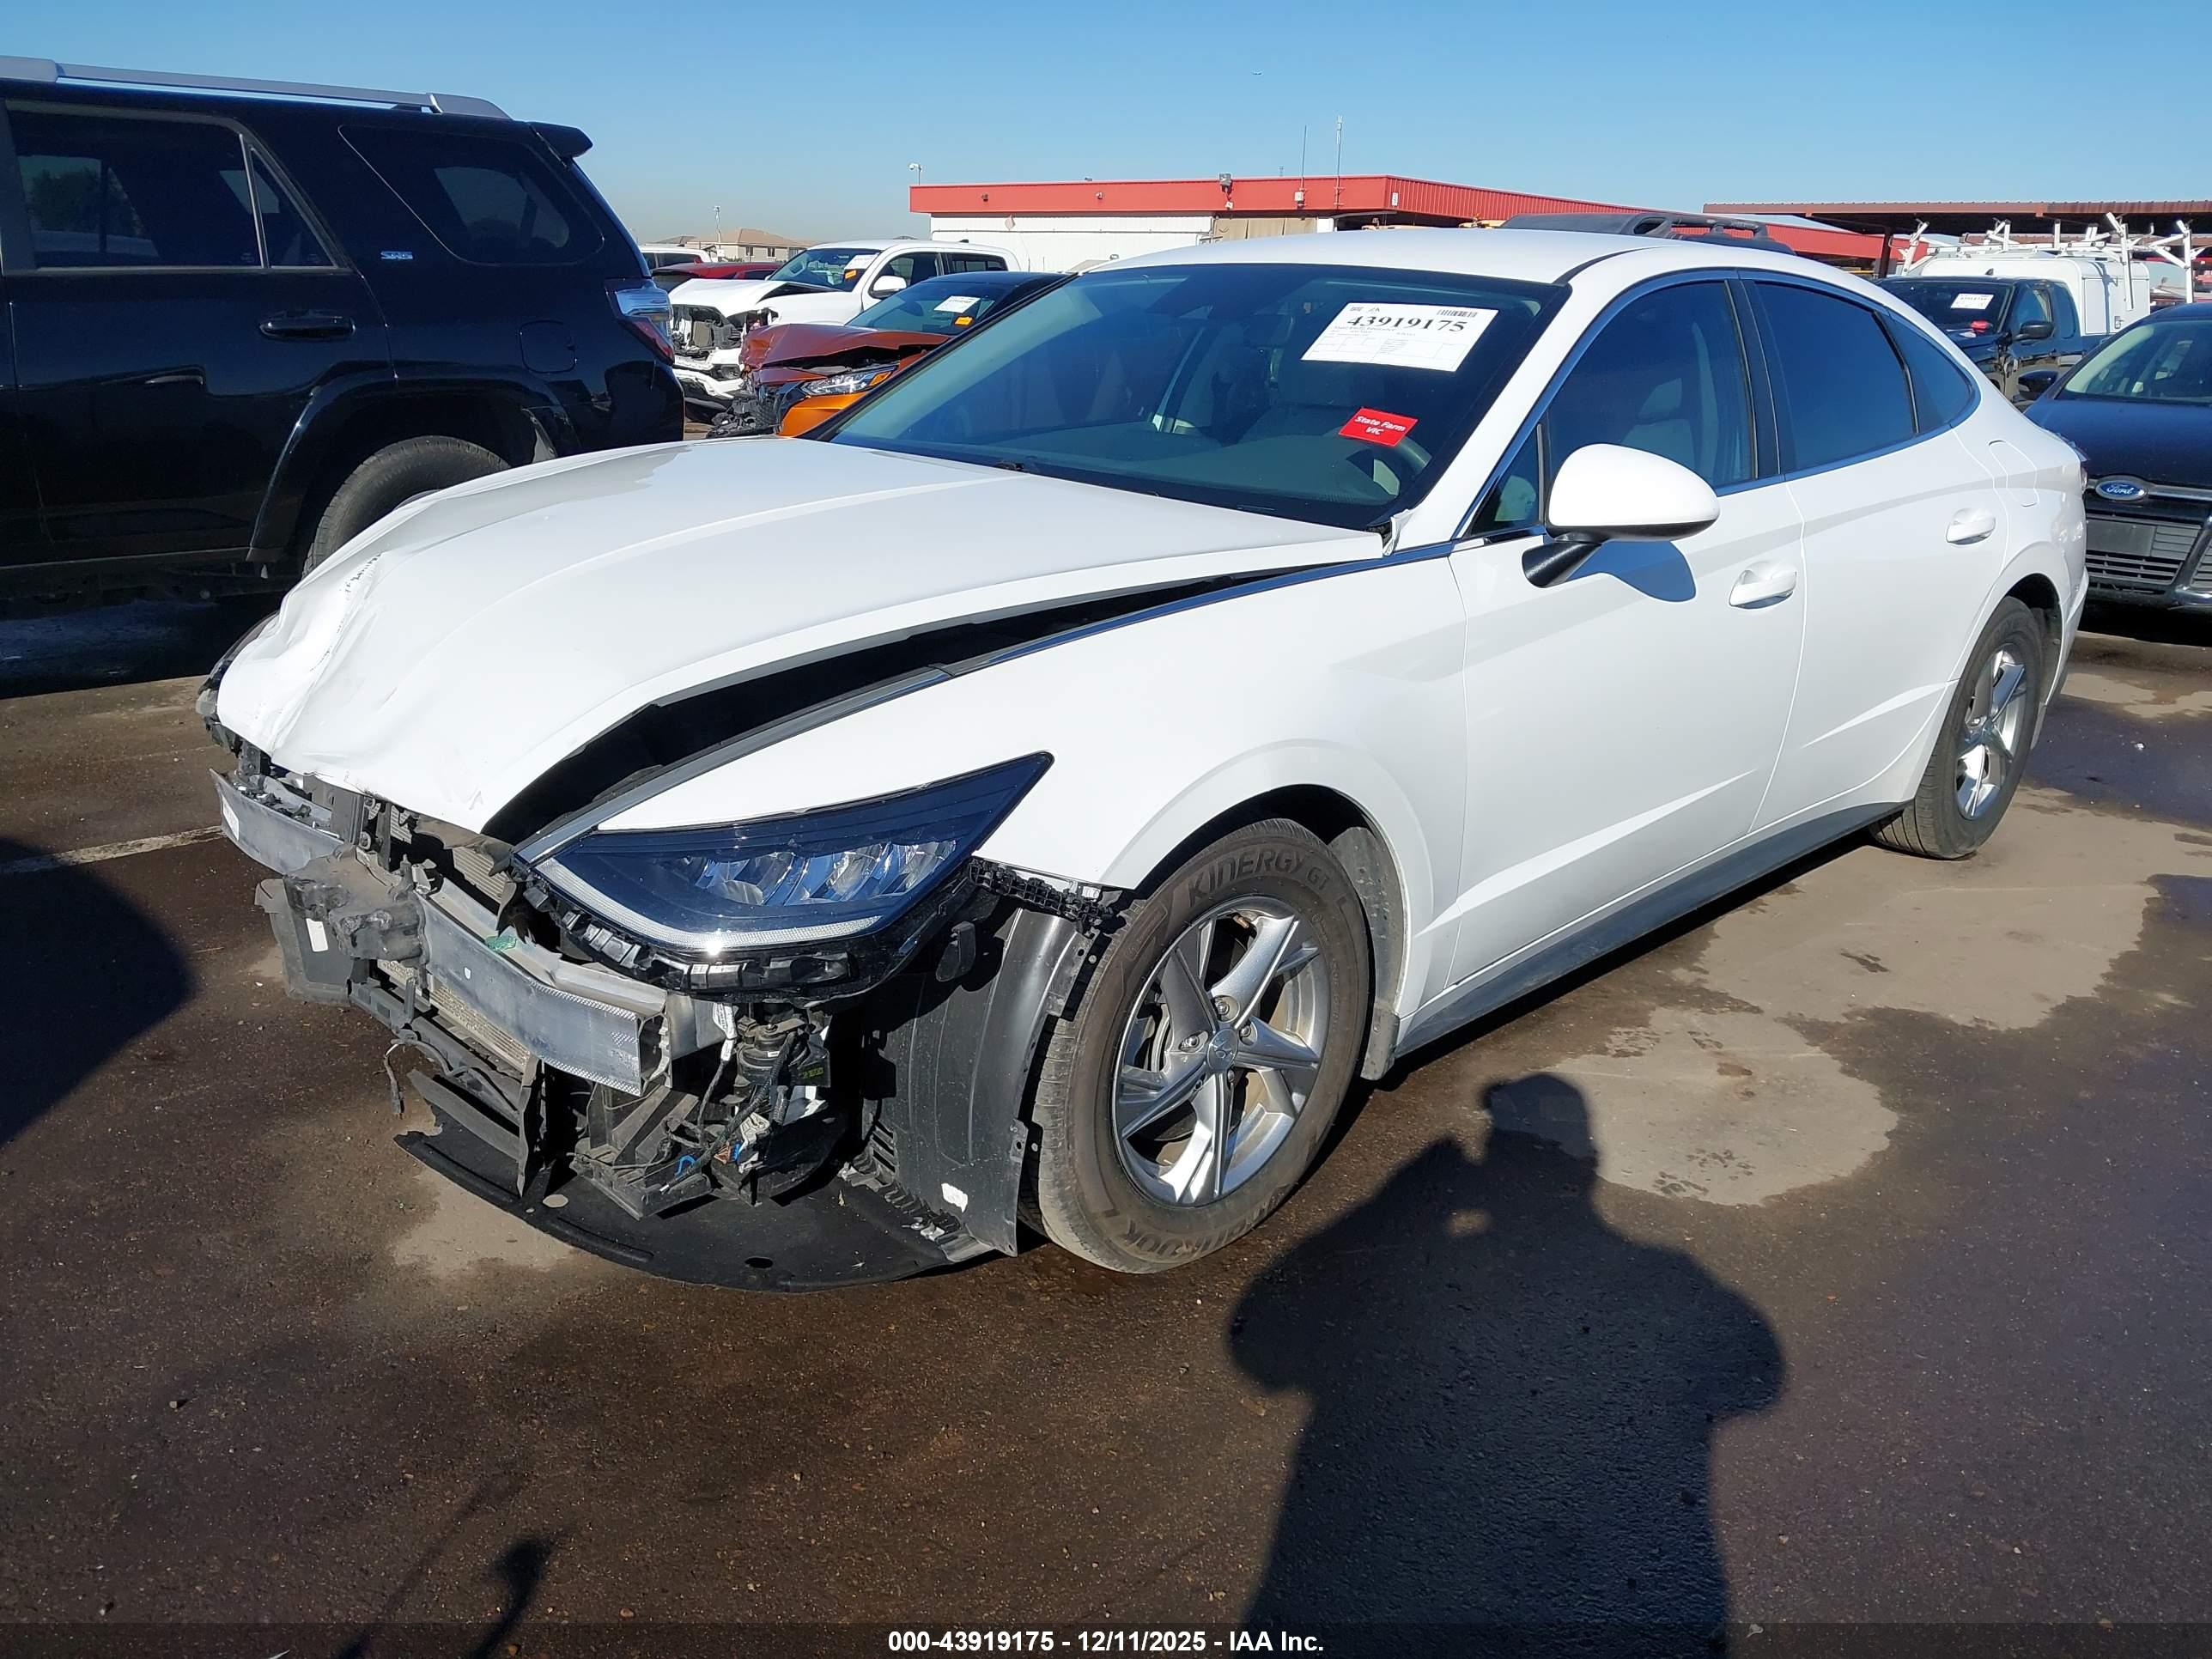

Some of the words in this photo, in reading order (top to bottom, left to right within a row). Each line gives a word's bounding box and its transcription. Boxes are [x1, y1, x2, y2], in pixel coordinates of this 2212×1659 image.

[1346, 314, 1469, 333] 43919175
[1354, 416, 1381, 427] State
[1380, 421, 1407, 432] Farm
[2106, 483, 2135, 495] Ford
